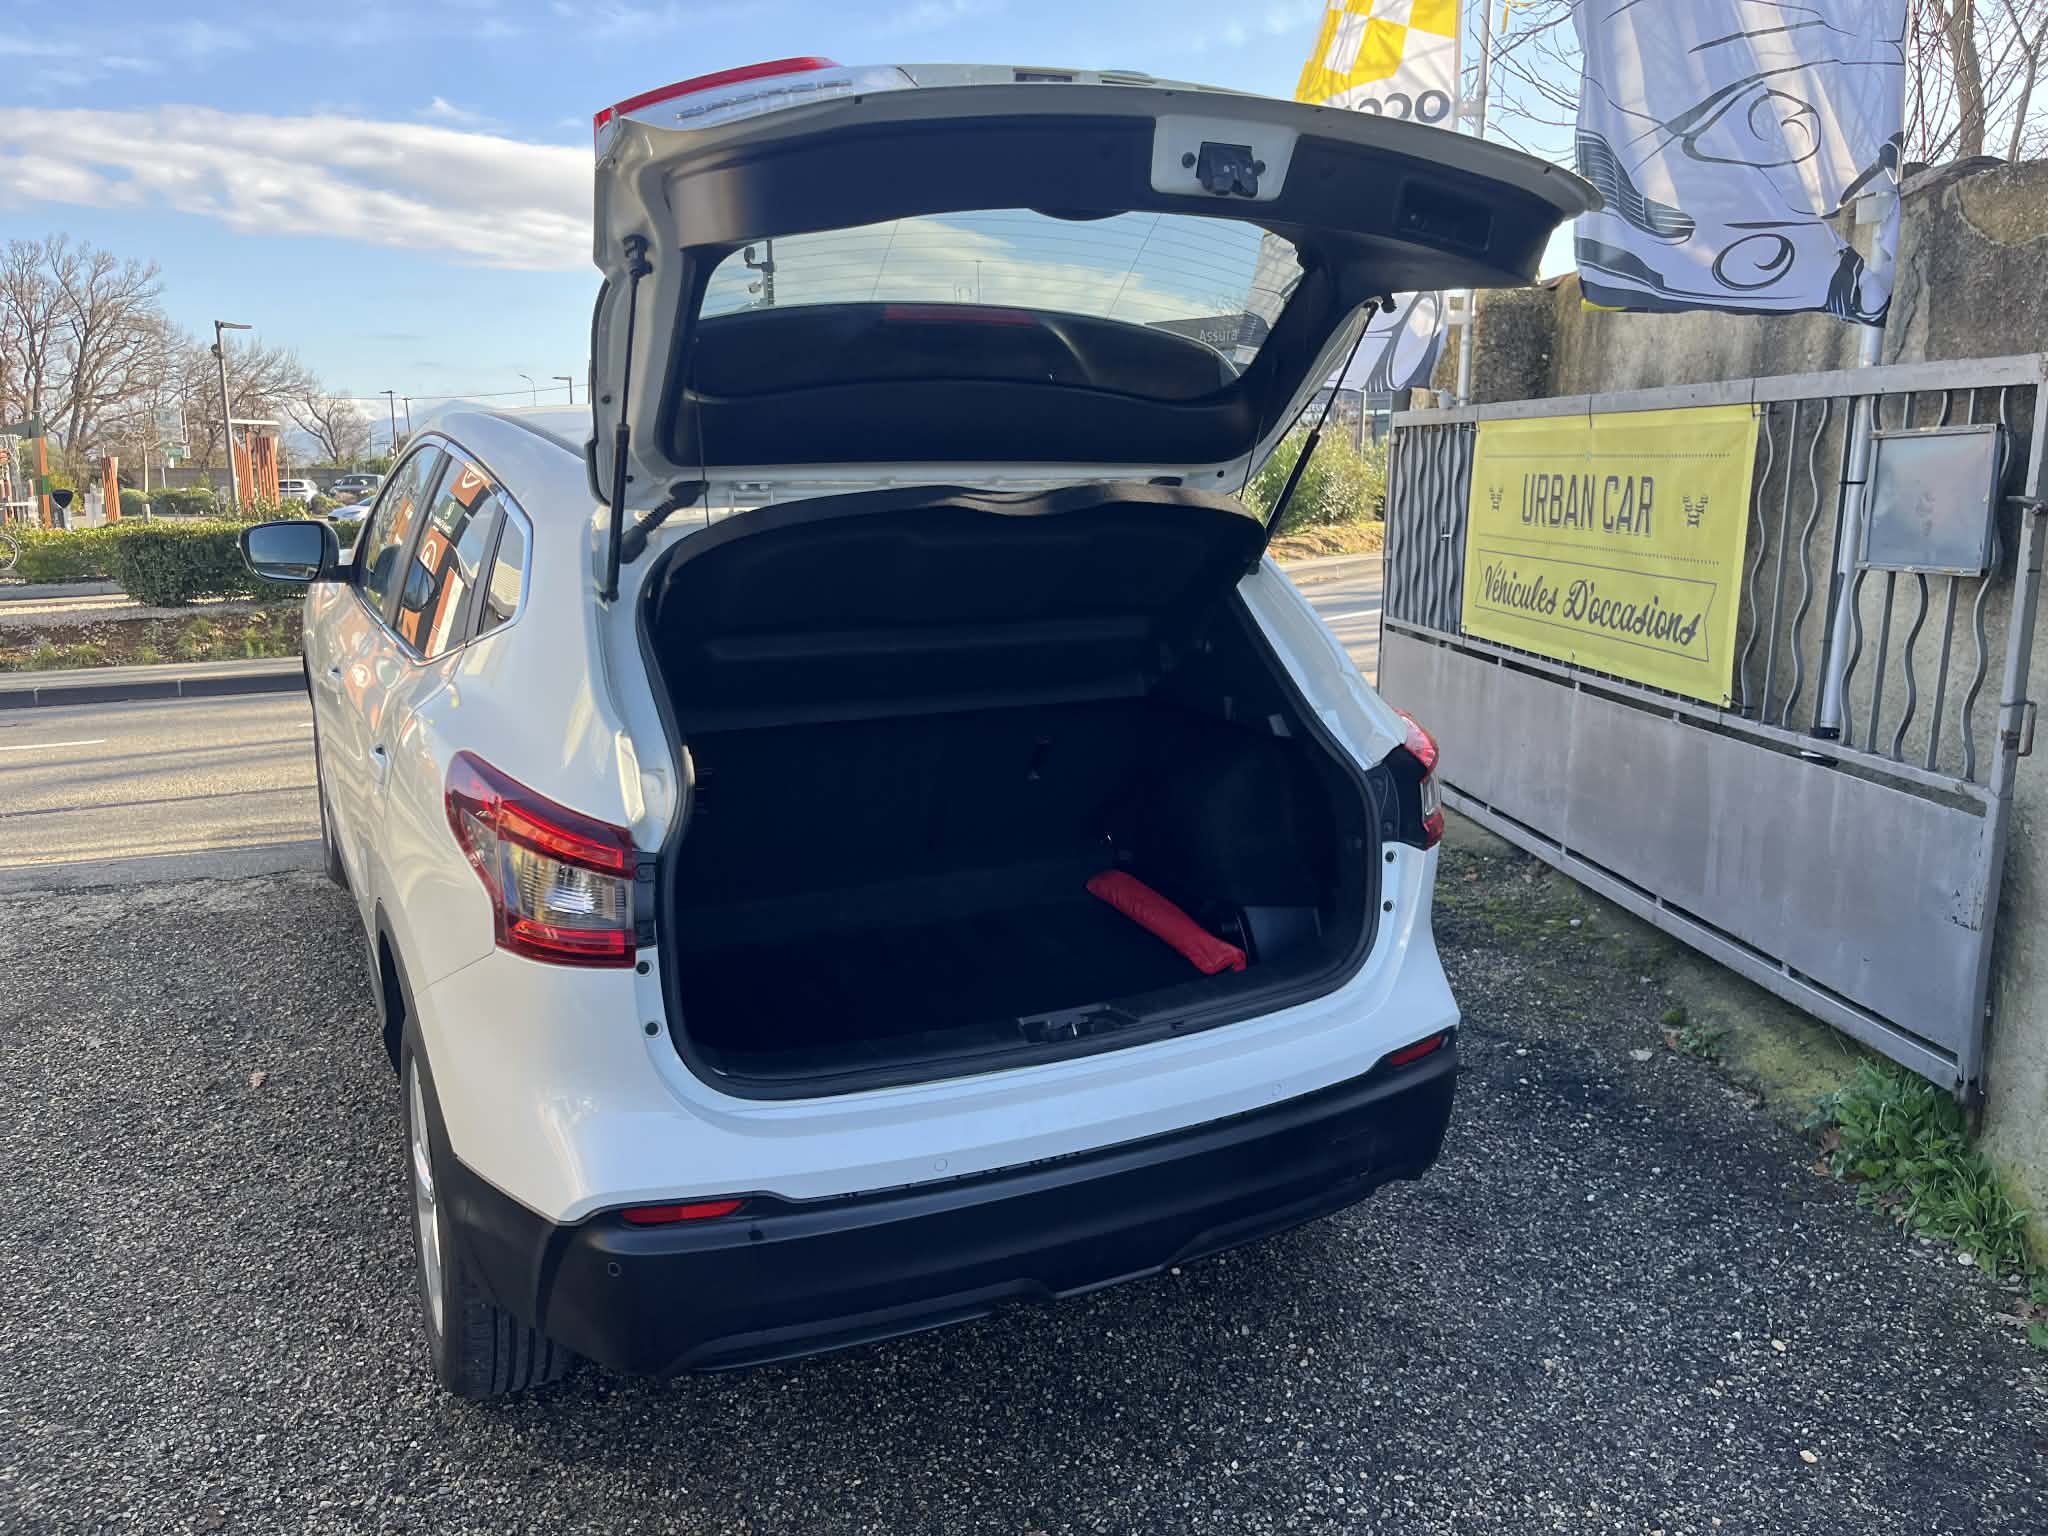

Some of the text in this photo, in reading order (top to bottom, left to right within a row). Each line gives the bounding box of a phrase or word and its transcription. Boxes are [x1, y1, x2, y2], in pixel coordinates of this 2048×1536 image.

[1521, 472, 1655, 537] URBAN CAR
[1485, 562, 1559, 615] Véhicules
